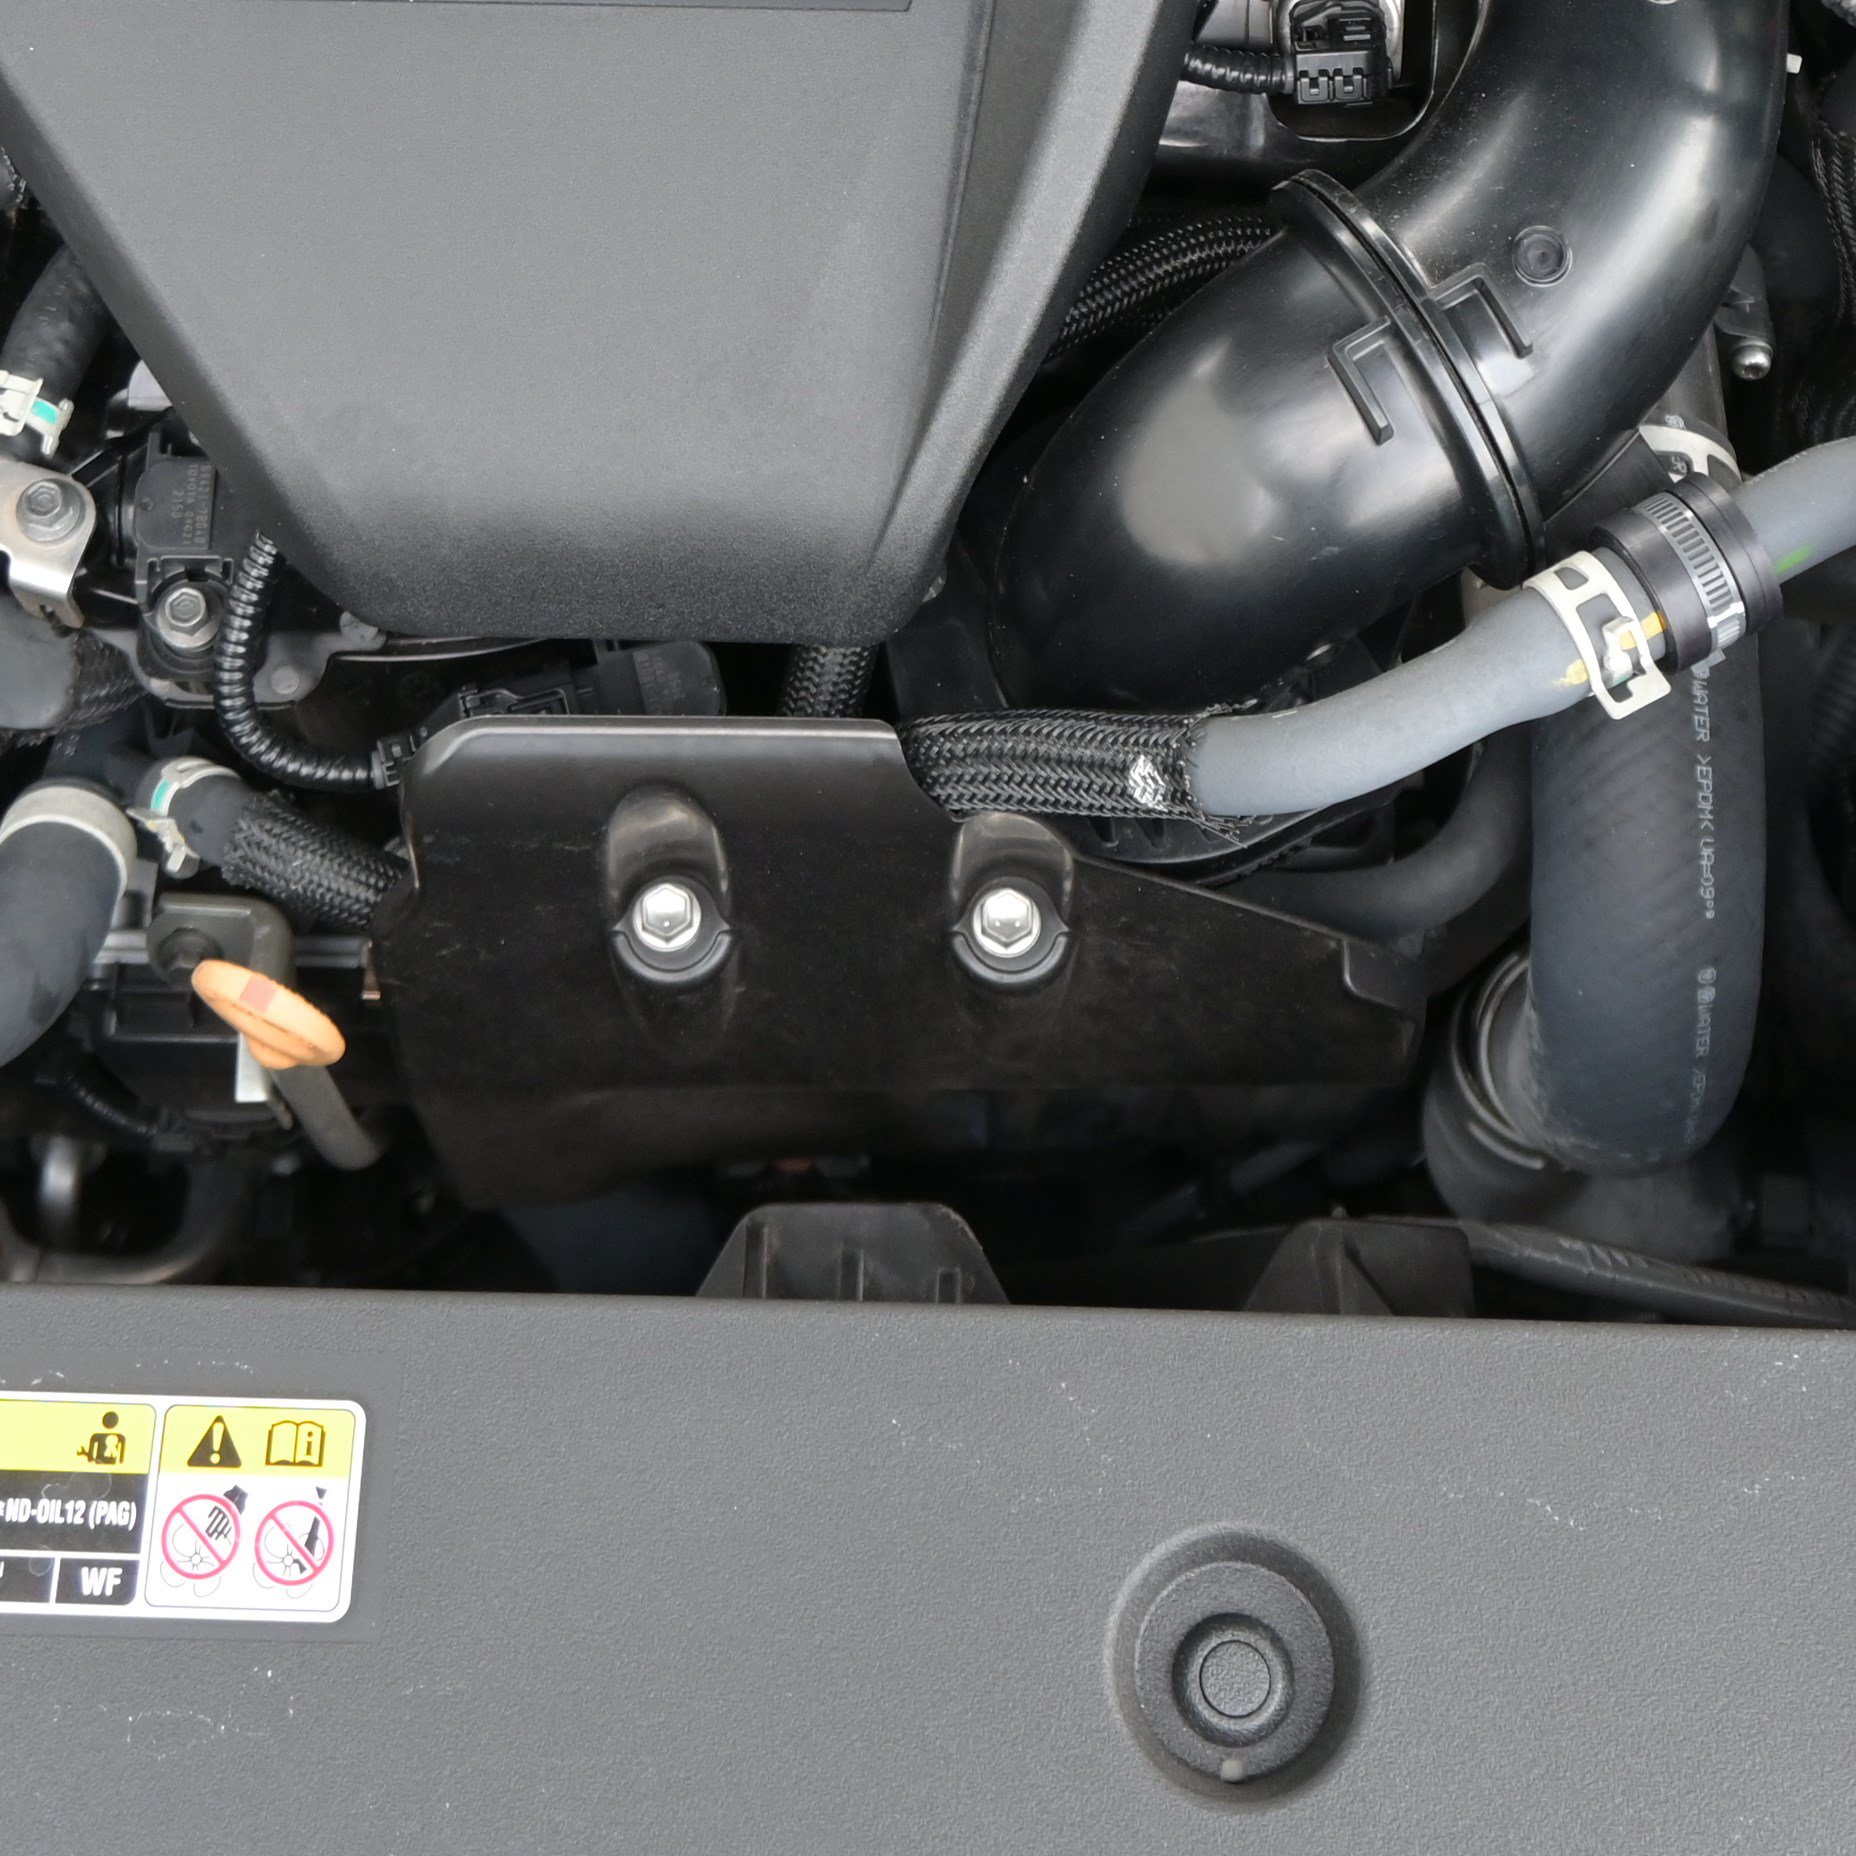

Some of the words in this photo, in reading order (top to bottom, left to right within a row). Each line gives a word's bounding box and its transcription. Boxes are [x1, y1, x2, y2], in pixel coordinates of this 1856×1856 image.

[185, 463, 198, 505] TOYOTA
[1691, 679, 1710, 743] WATER
[1695, 1005, 1714, 1059] WATER
[5, 1498, 88, 1528] ND-OIL12
[89, 1500, 138, 1532] (PAG)
[80, 1566, 122, 1597] WF
